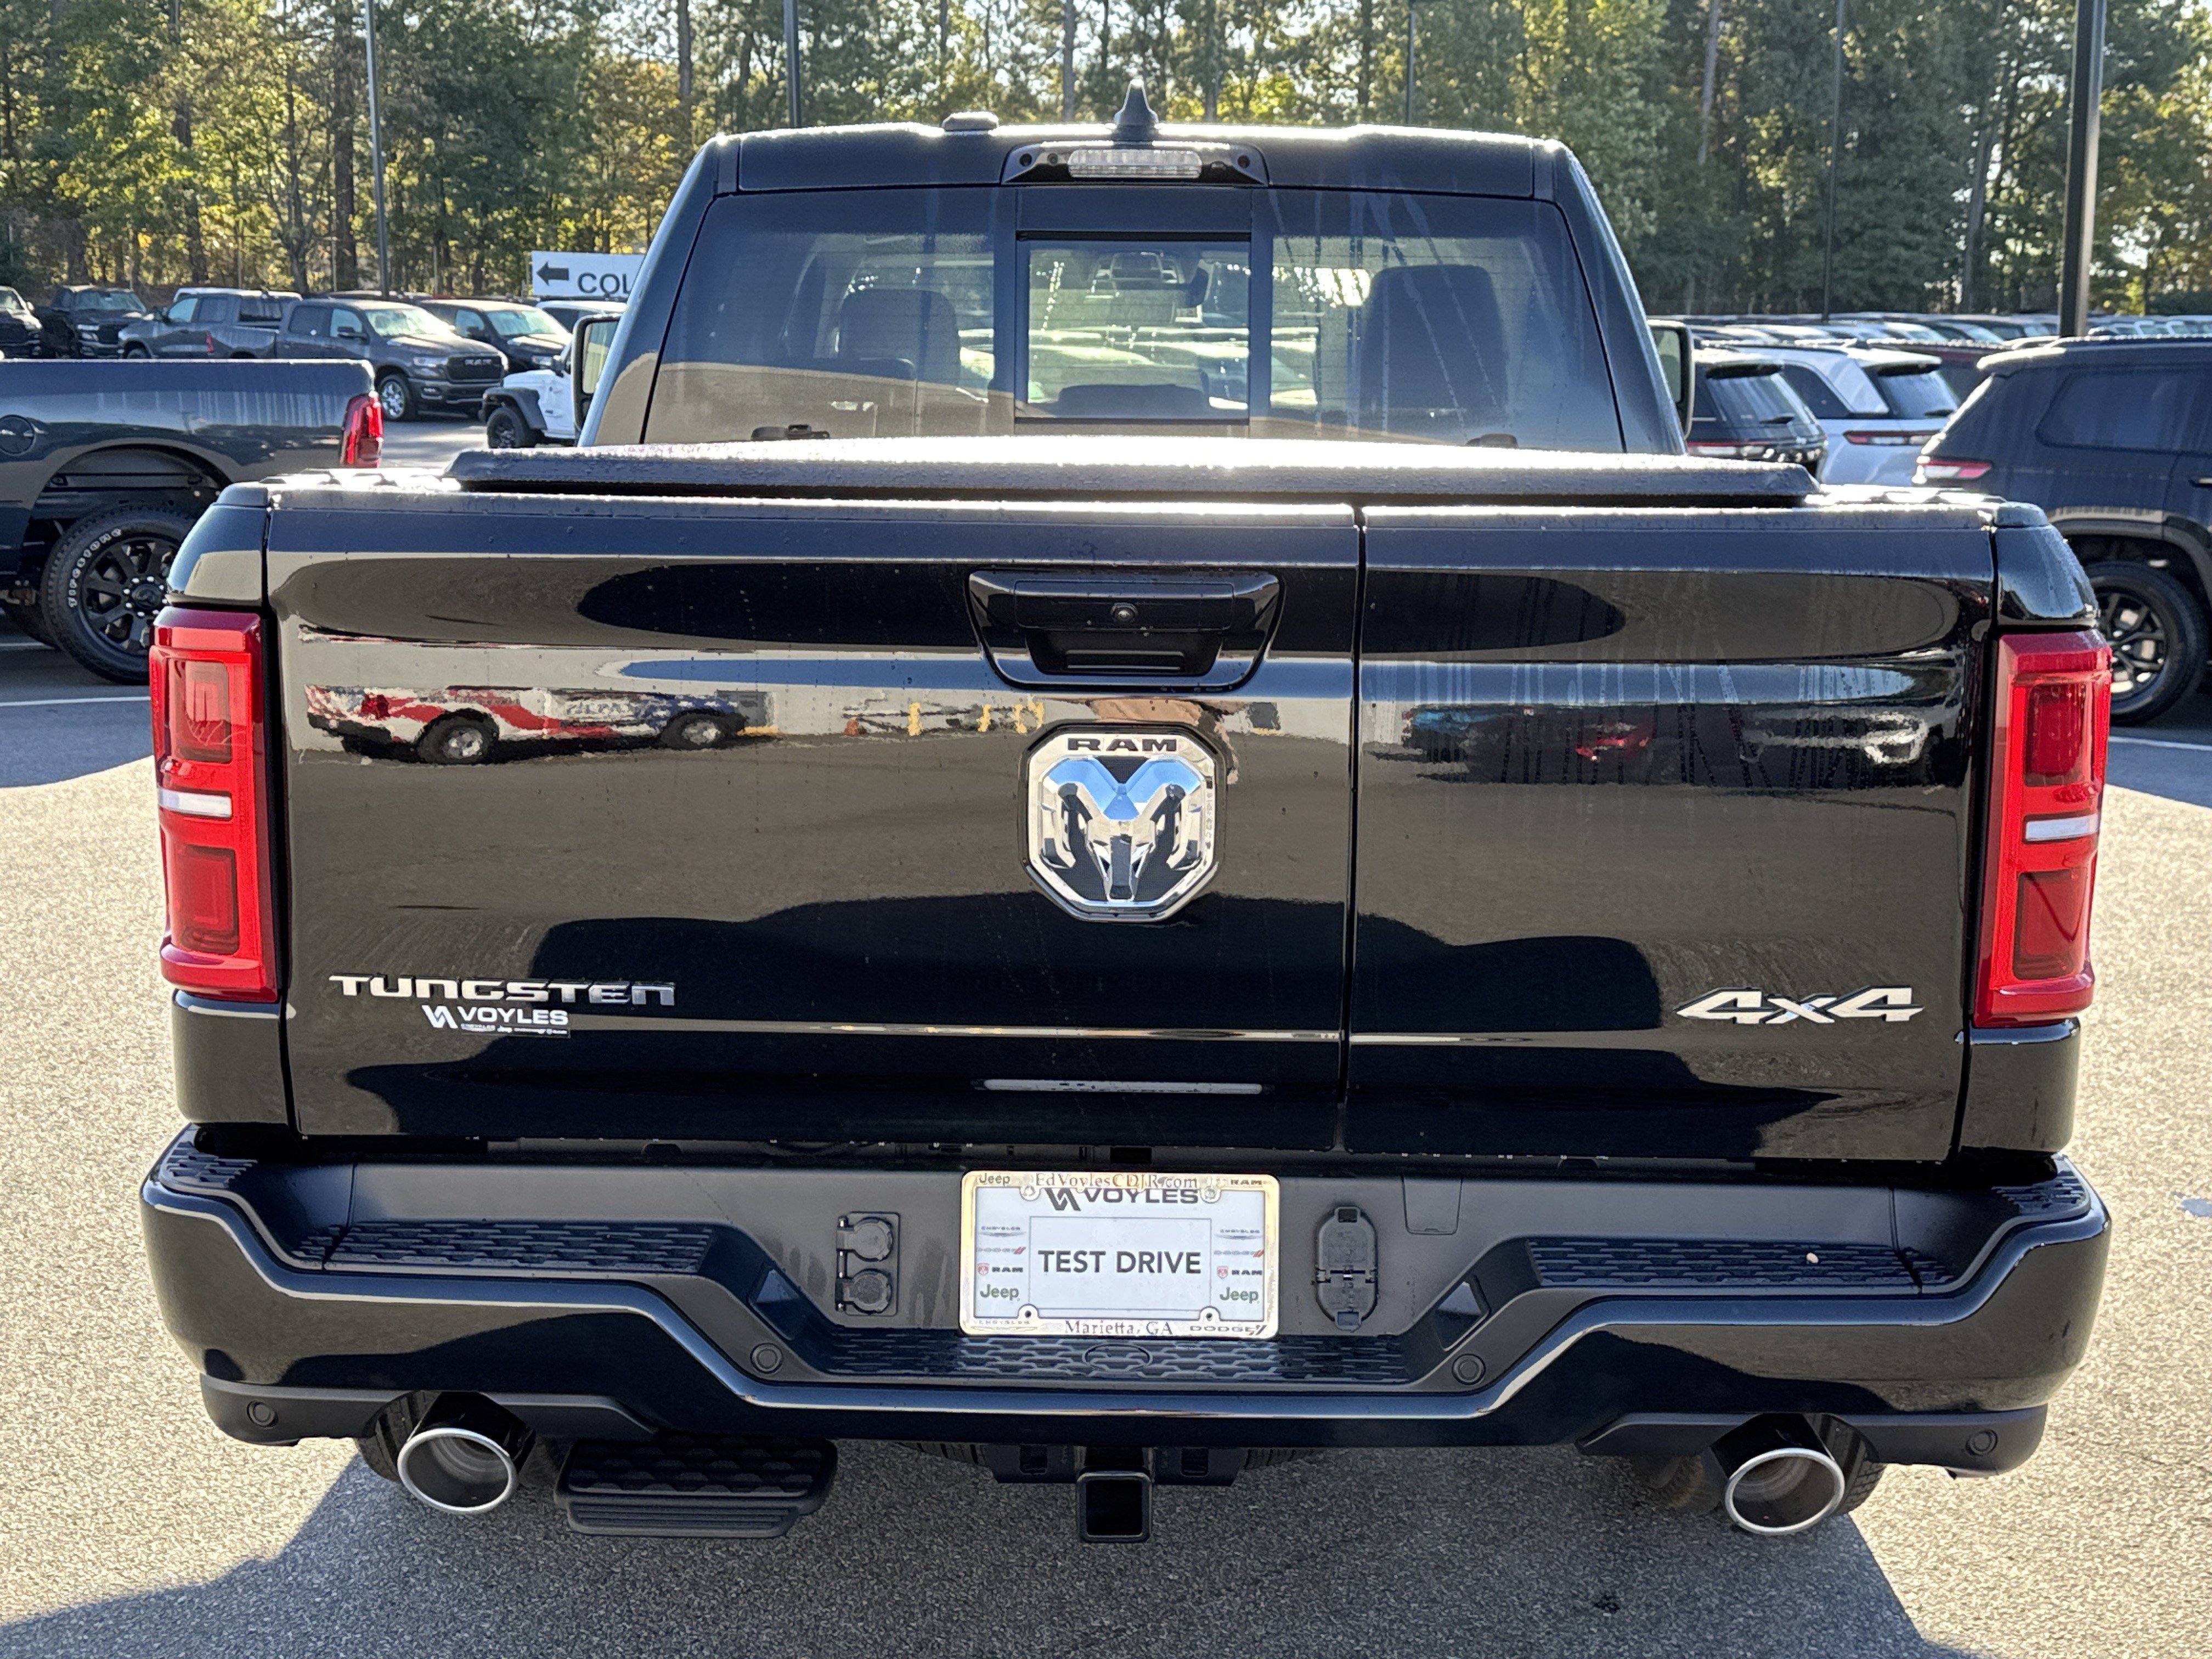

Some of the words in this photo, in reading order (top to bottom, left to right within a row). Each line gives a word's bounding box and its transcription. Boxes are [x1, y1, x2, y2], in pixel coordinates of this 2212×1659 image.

[1068, 738, 1177, 752] RAM
[329, 973, 675, 1006] TUNGSTEN
[457, 1006, 568, 1025] VOYLES
[979, 1173, 1010, 1186] Jeep
[1084, 1188, 1198, 1204] VOYLES
[1038, 1250, 1106, 1273] TEST
[1117, 1251, 1201, 1274] DRIVE
[979, 1284, 1019, 1301] Jeep
[1220, 1286, 1259, 1304] Jeep
[1146, 1321, 1173, 1335] GA
